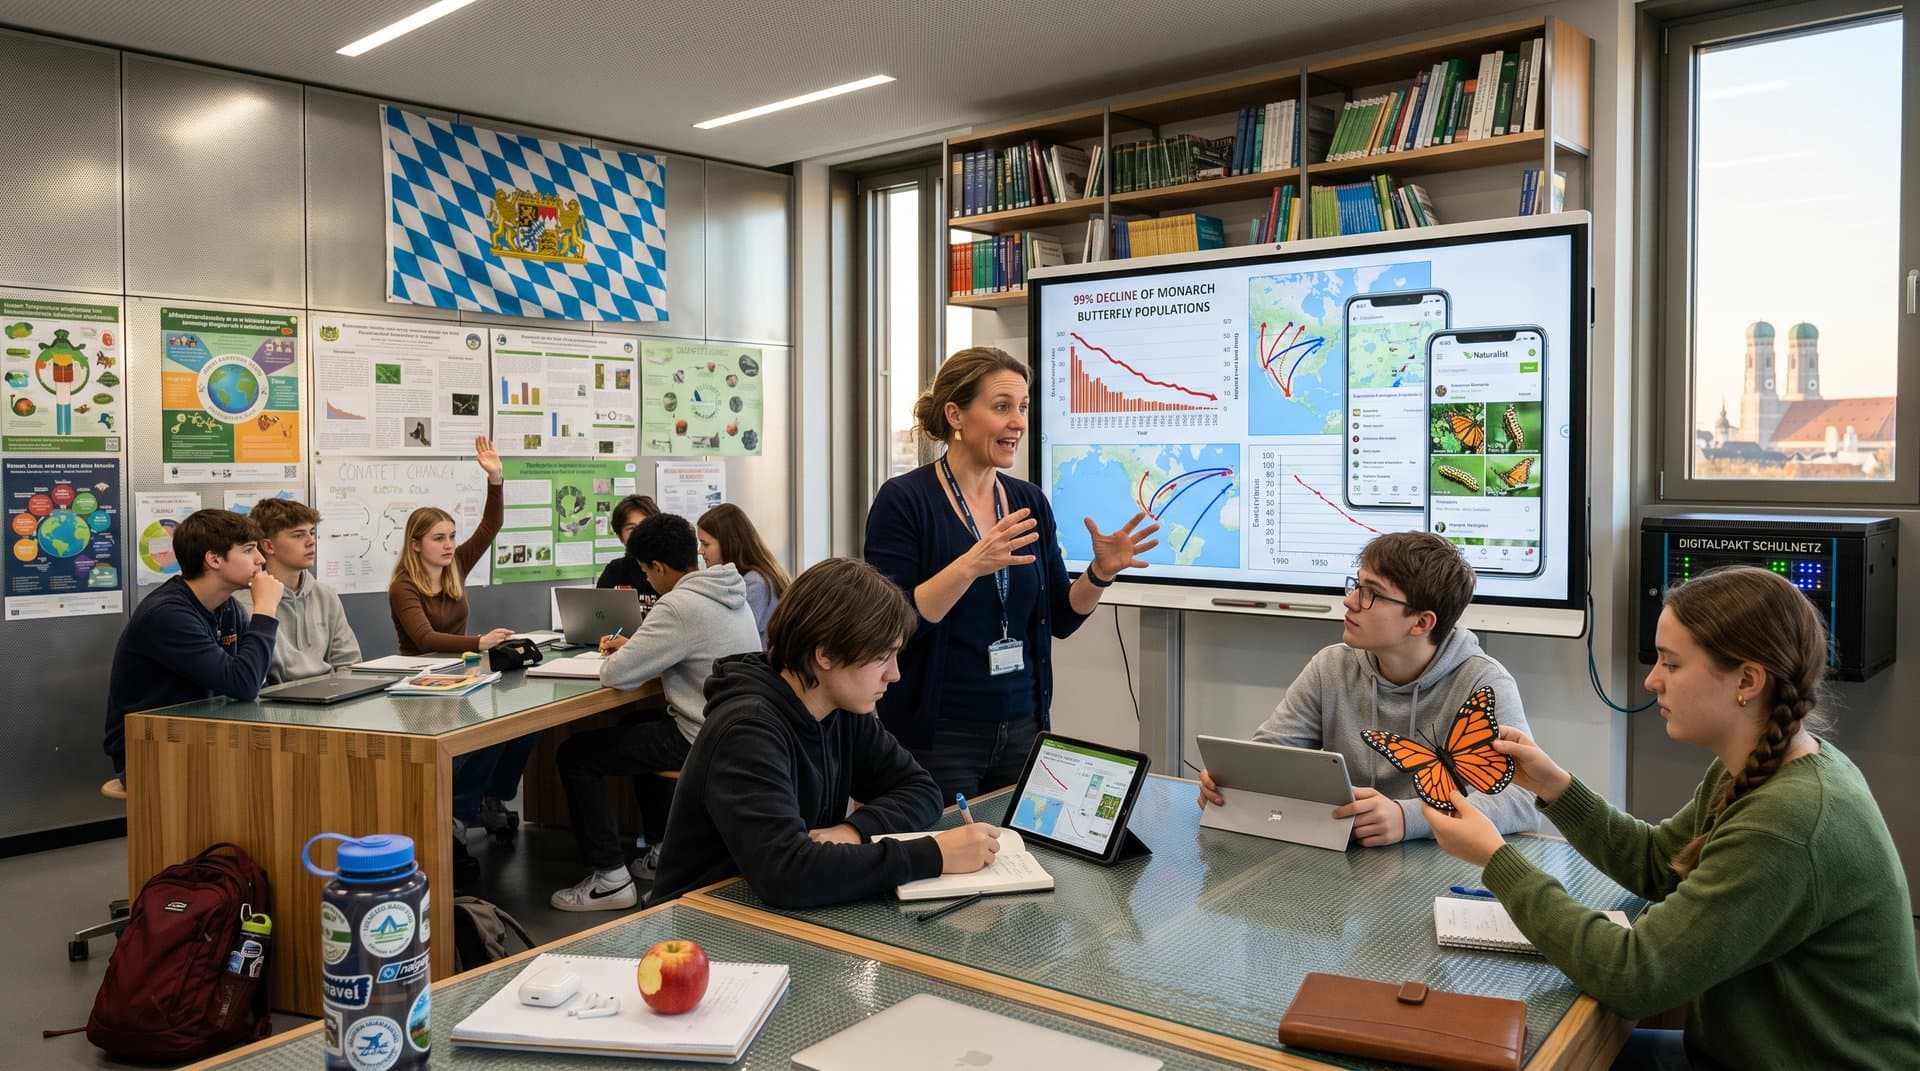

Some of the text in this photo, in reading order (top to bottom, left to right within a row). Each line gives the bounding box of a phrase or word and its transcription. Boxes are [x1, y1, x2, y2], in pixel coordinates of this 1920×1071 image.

[1073, 283, 1216, 306] 99% DECLINE OF MONARCH
[1077, 301, 1210, 322] BUTTERFLY POPULATIONS
[1473, 350, 1508, 359] Naturalist
[1679, 538, 1822, 553] DIGITALPAKT SCHULNETZ
